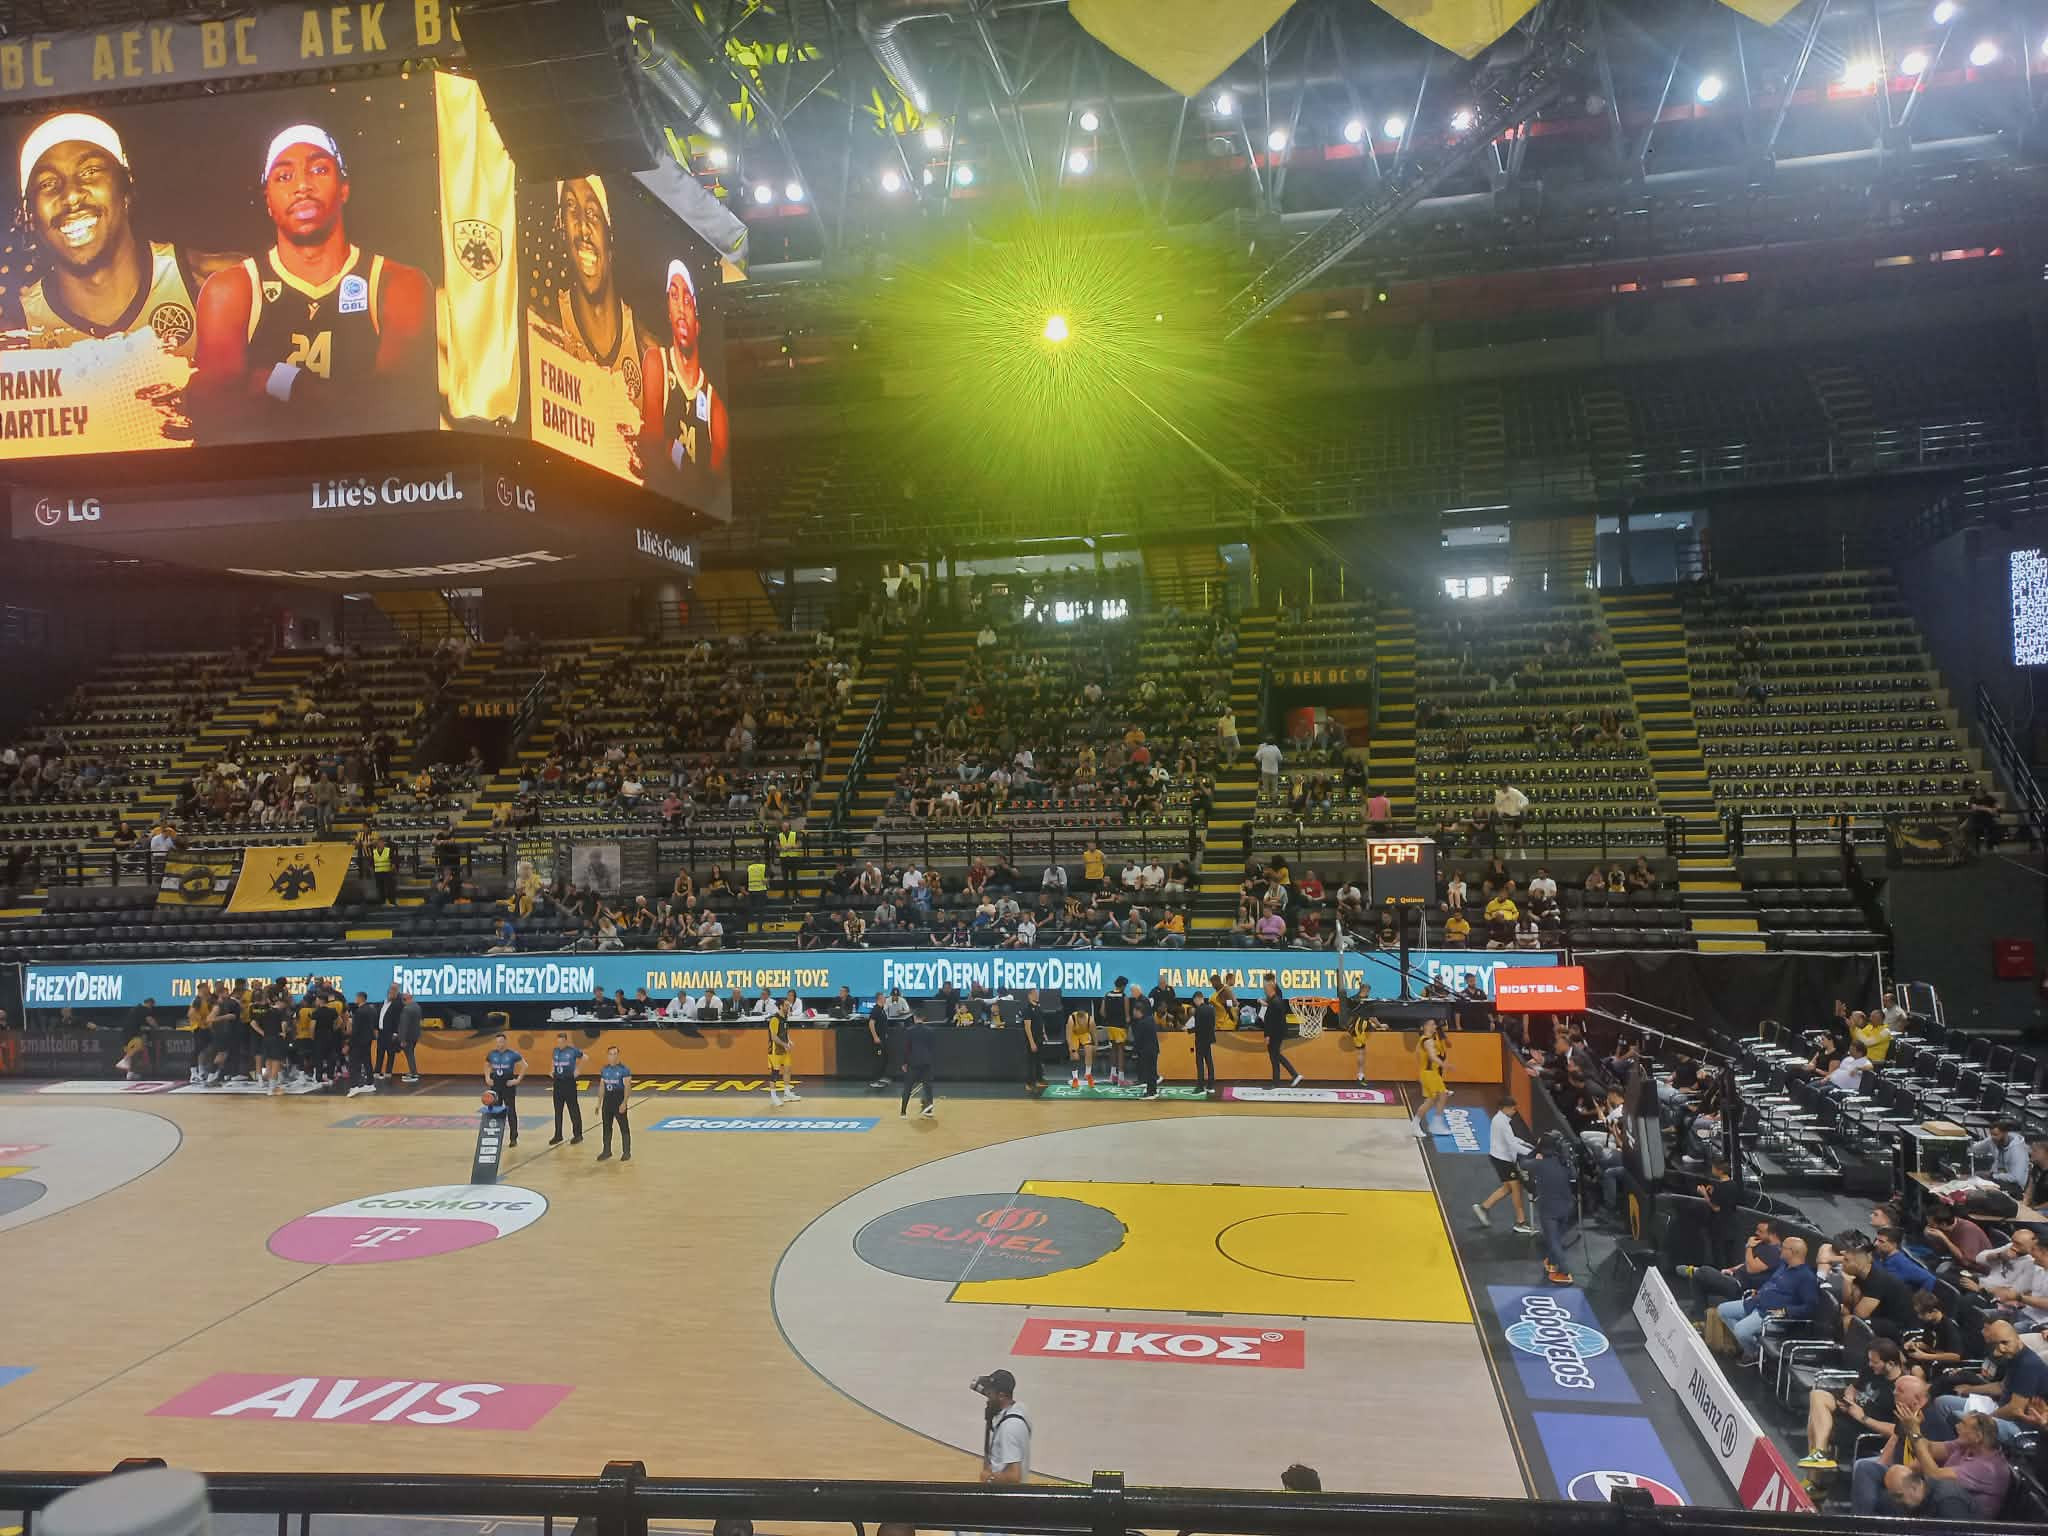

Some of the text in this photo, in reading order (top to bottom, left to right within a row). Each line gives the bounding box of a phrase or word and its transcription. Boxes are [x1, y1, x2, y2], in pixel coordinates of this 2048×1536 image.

[1, 40, 54, 91] BC
[92, 27, 175, 81] AEK
[201, 17, 258, 69] BC
[302, 2, 386, 58] AEK
[341, 301, 365, 311] GBL
[286, 331, 332, 379] 24
[0, 367, 63, 401] RANK
[540, 357, 583, 407] FRANK
[0, 405, 88, 440] ARTLEY
[542, 397, 596, 449] BARTLEY
[311, 471, 463, 509] Life's Good.
[515, 484, 537, 513] LG
[67, 498, 101, 522] LG
[636, 527, 694, 568] Life's Good.
[172, 978, 192, 998] ΓΙΑ
[646, 969, 829, 989] ΓΙΑ ΜΑΛΛΙΑ ΣΤΗ ΘΕΣΗ ΤΟΥΣ
[1281, 969, 1321, 989] ΘΕΣΗ
[1500, 984, 1563, 994] BIOSTEEL
[357, 1199, 533, 1212] COSMOTE
[900, 1223, 1062, 1256] SUNEL
[1042, 1328, 1262, 1361] ΒΙΚΟΣ
[210, 1377, 505, 1424] AVIS
[1688, 1367, 1723, 1433] Allianz
